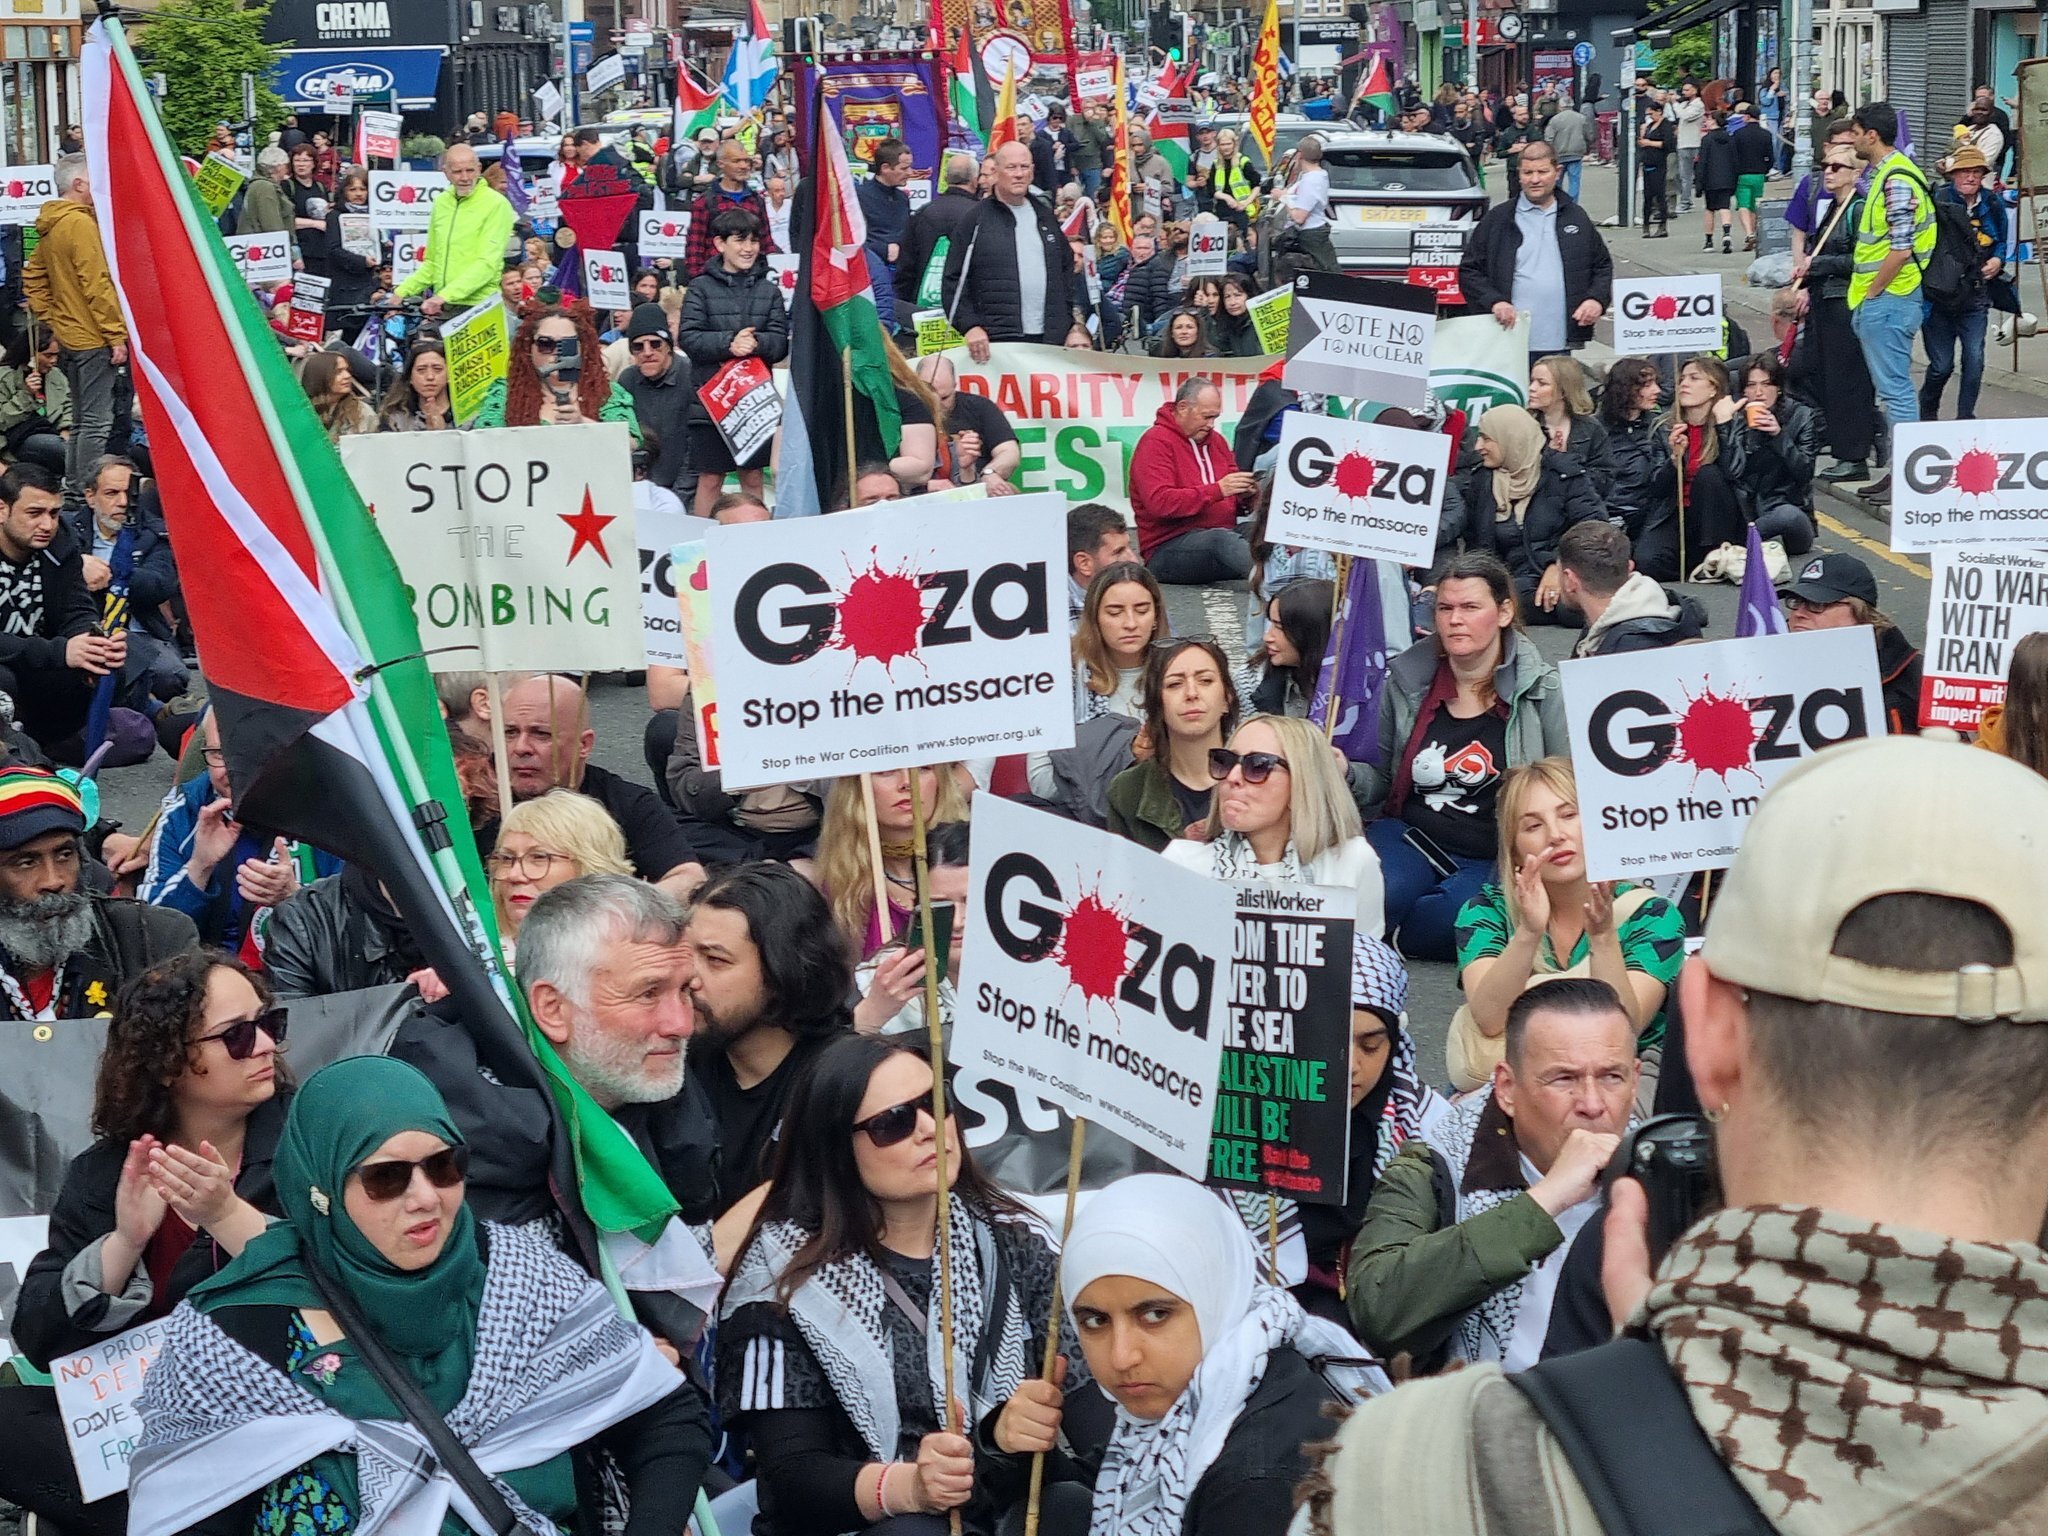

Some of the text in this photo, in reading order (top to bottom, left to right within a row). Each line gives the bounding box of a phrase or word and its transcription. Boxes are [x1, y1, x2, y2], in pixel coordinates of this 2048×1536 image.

[316, 2, 390, 31] CREMA
[304, 75, 383, 91] CMA
[1158, 103, 1192, 113] Gza
[375, 181, 445, 203] Gza
[229, 244, 285, 262] Gza
[1192, 233, 1225, 252] Gza
[1414, 232, 1463, 247] FREEDOM
[589, 259, 624, 283] Gza
[1623, 290, 1715, 321] Gza
[1623, 326, 1716, 339] Stop the massacre
[1347, 342, 1424, 365] NUCLEAR
[406, 460, 550, 513] STOP
[1289, 436, 1436, 506] Gza
[1905, 444, 2048, 495] Gza
[1282, 500, 1428, 537] Stop the massacre
[1905, 510, 1943, 527] Stop
[1948, 507, 1974, 523] the
[447, 525, 525, 558] THE
[1945, 566, 2048, 608] NO WAR
[734, 561, 1049, 666] Gza
[1942, 602, 2012, 640] WITH
[1937, 638, 2002, 676] IRAN
[742, 670, 1055, 729] Stop the massacre
[1933, 680, 1976, 702] Down
[1588, 687, 1868, 777] Gza
[1930, 701, 1982, 726] imperi
[761, 726, 1043, 770] Stop the War Coalition www.stopwar.org.uk
[1601, 805, 1668, 831] Stop
[1676, 797, 1723, 822] the
[1621, 855, 1646, 866] Stop
[1650, 853, 1667, 864] the
[1670, 850, 1693, 861] War
[985, 852, 1216, 1041] Gza
[1272, 922, 1326, 967] THE
[1274, 967, 1307, 1011] TO
[977, 982, 1203, 1108] Stop the massacre
[1251, 1010, 1295, 1054] SEA
[982, 1049, 1187, 1153] Stop the War Coalition www.stopwar.org.uk
[1261, 1100, 1291, 1143] BE
[1208, 1138, 1259, 1182] REE
[60, 1355, 93, 1383] NO
